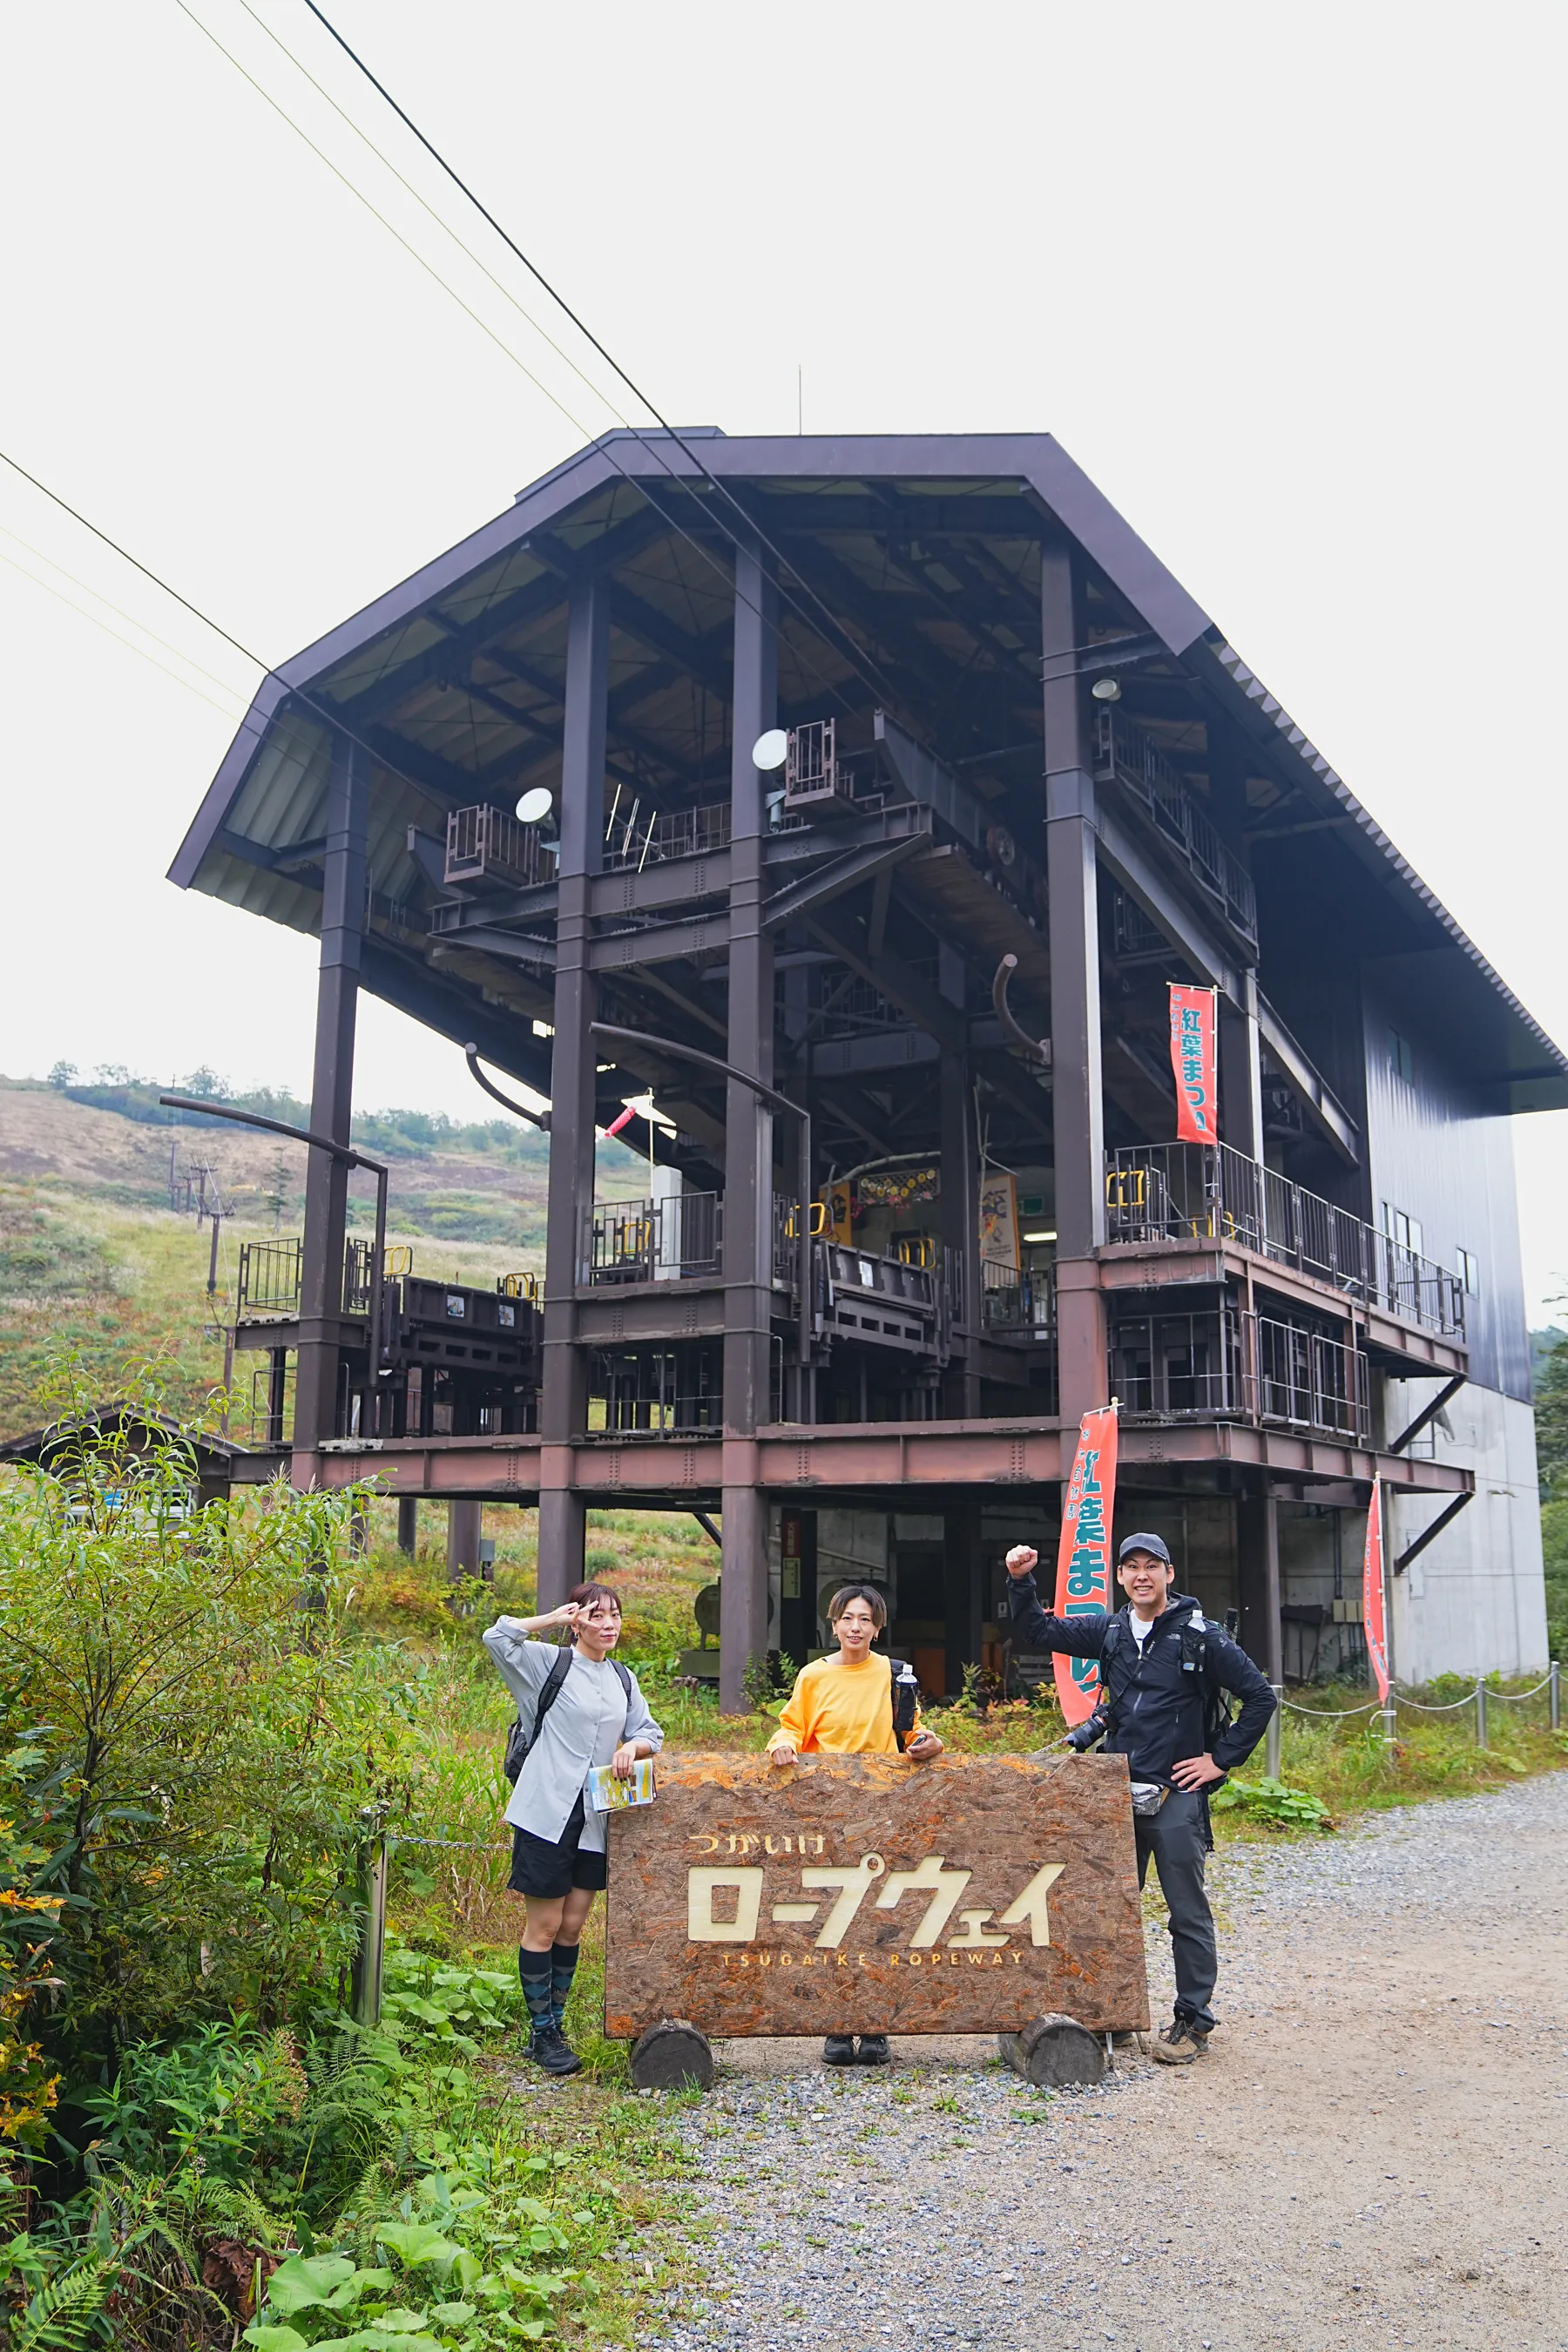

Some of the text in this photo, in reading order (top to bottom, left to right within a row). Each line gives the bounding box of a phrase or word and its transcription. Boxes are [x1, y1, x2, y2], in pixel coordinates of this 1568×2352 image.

[689, 1834, 826, 1855] つがいけ
[687, 1850, 1068, 1949] ロープウェイ
[722, 1951, 1024, 1967] TSUGAIKE ROPEWAY
